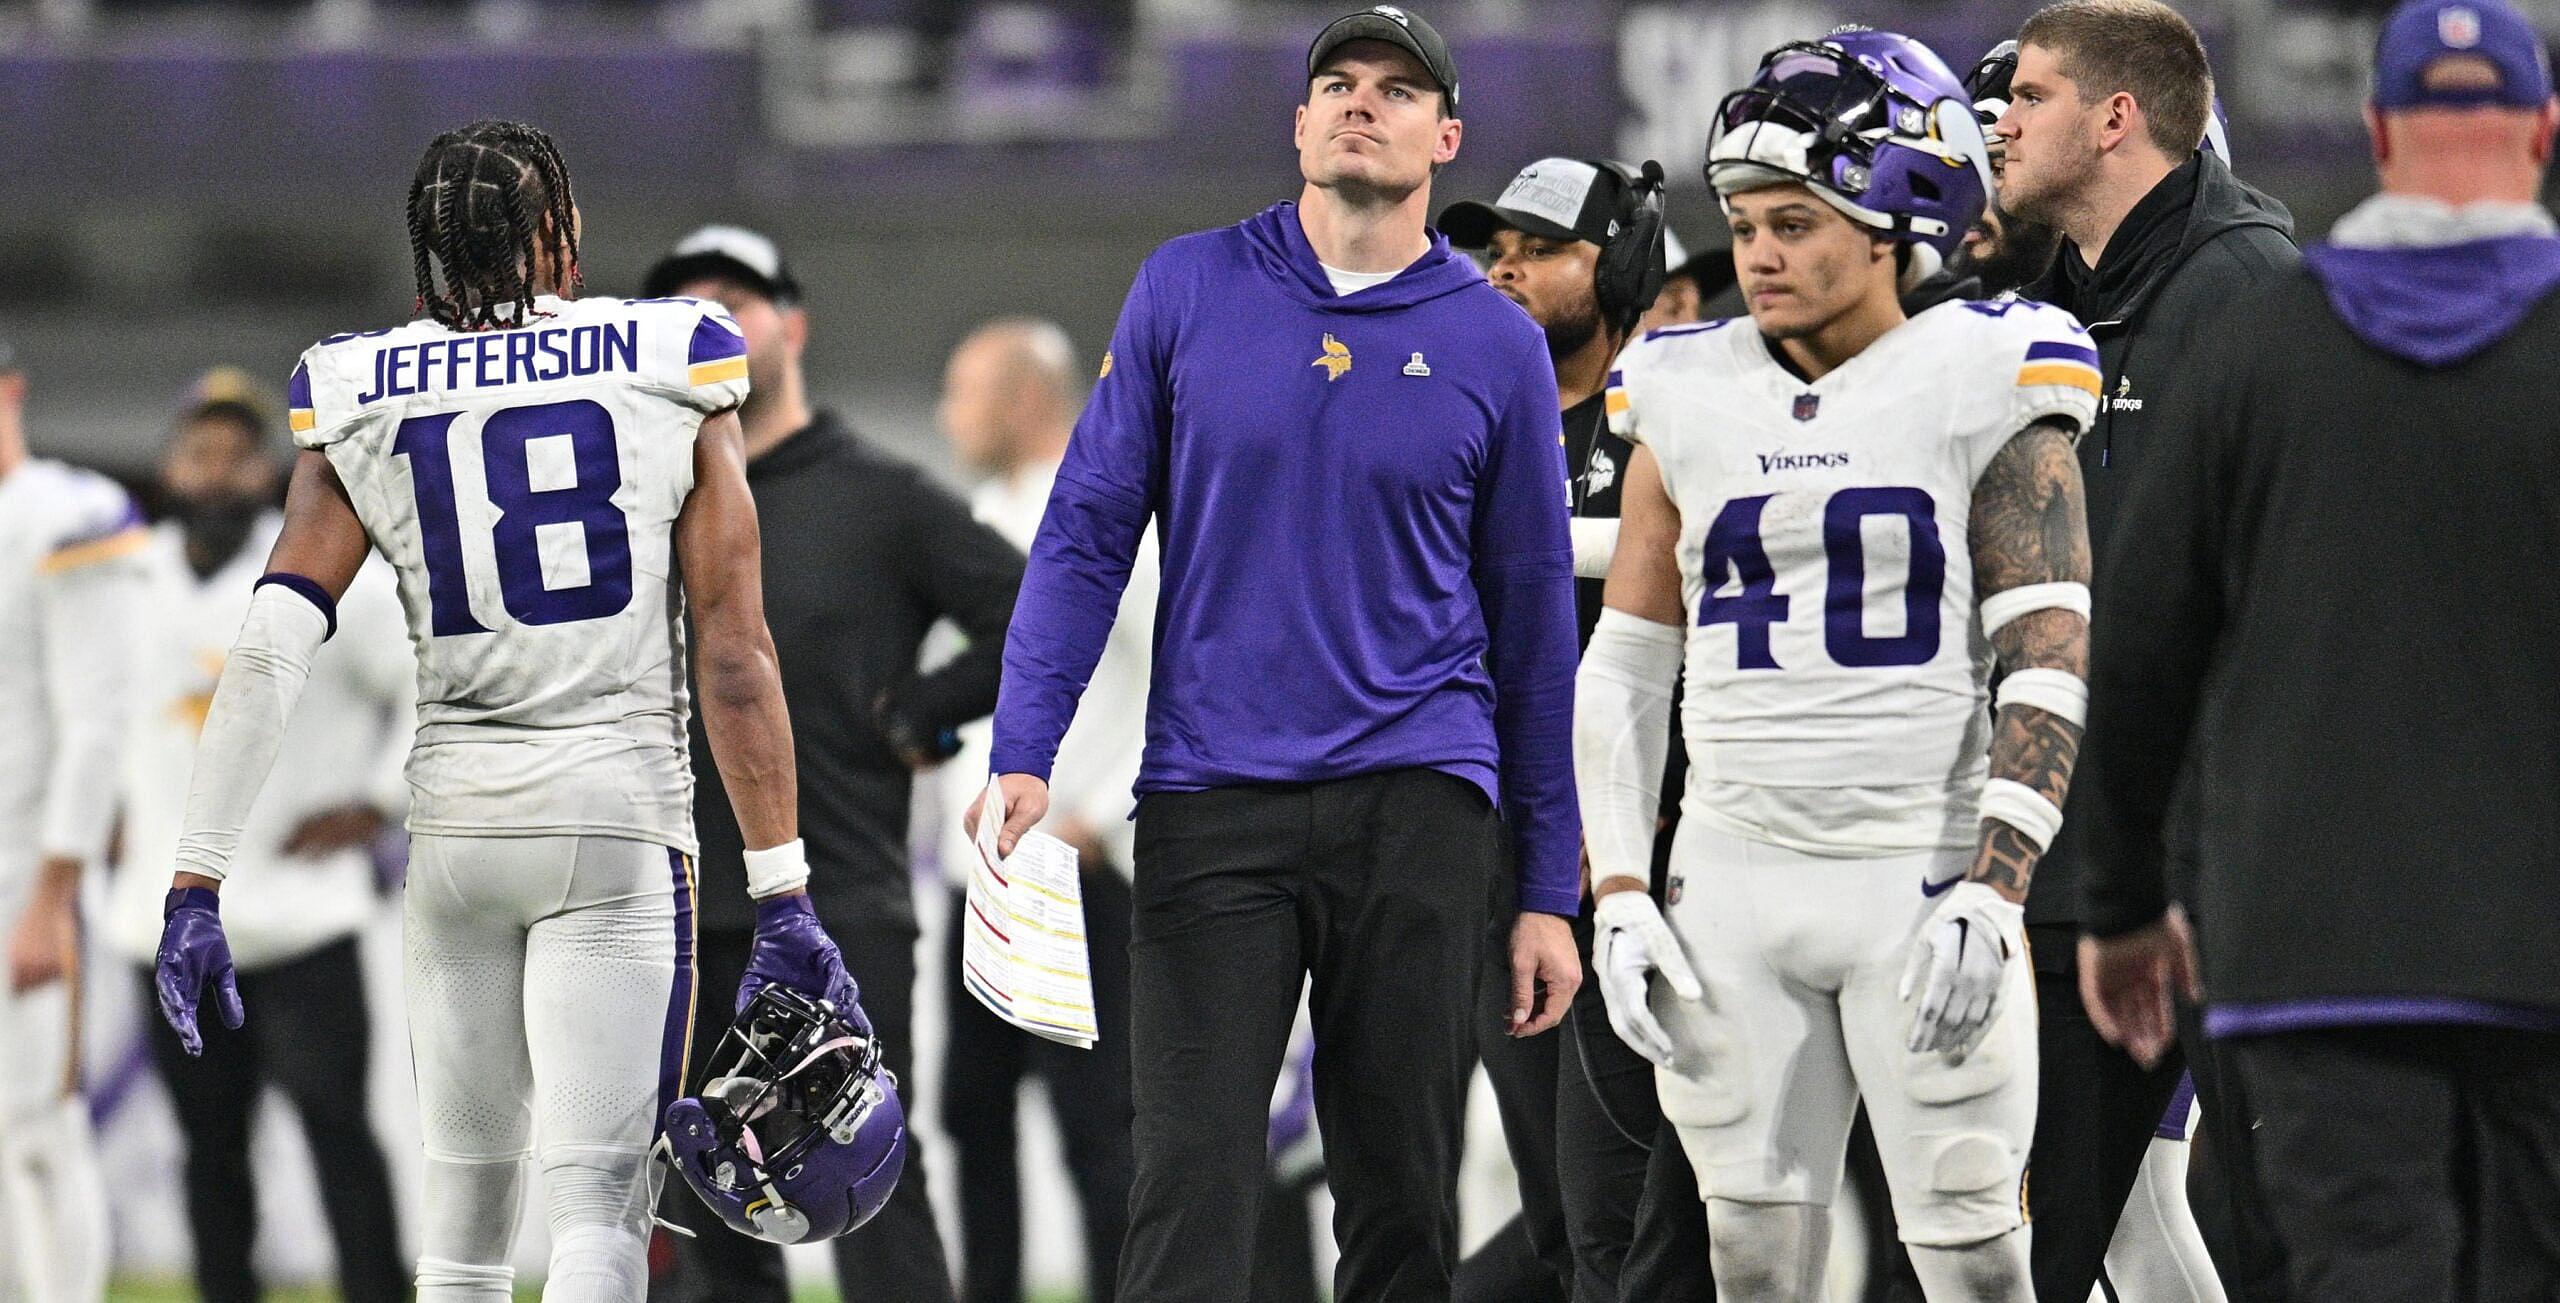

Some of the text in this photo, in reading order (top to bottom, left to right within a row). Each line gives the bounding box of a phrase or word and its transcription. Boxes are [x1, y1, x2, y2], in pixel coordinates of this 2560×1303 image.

[358, 320, 637, 404] JEFFERSON
[391, 399, 633, 637] 18
[1697, 487, 1946, 669] 40
